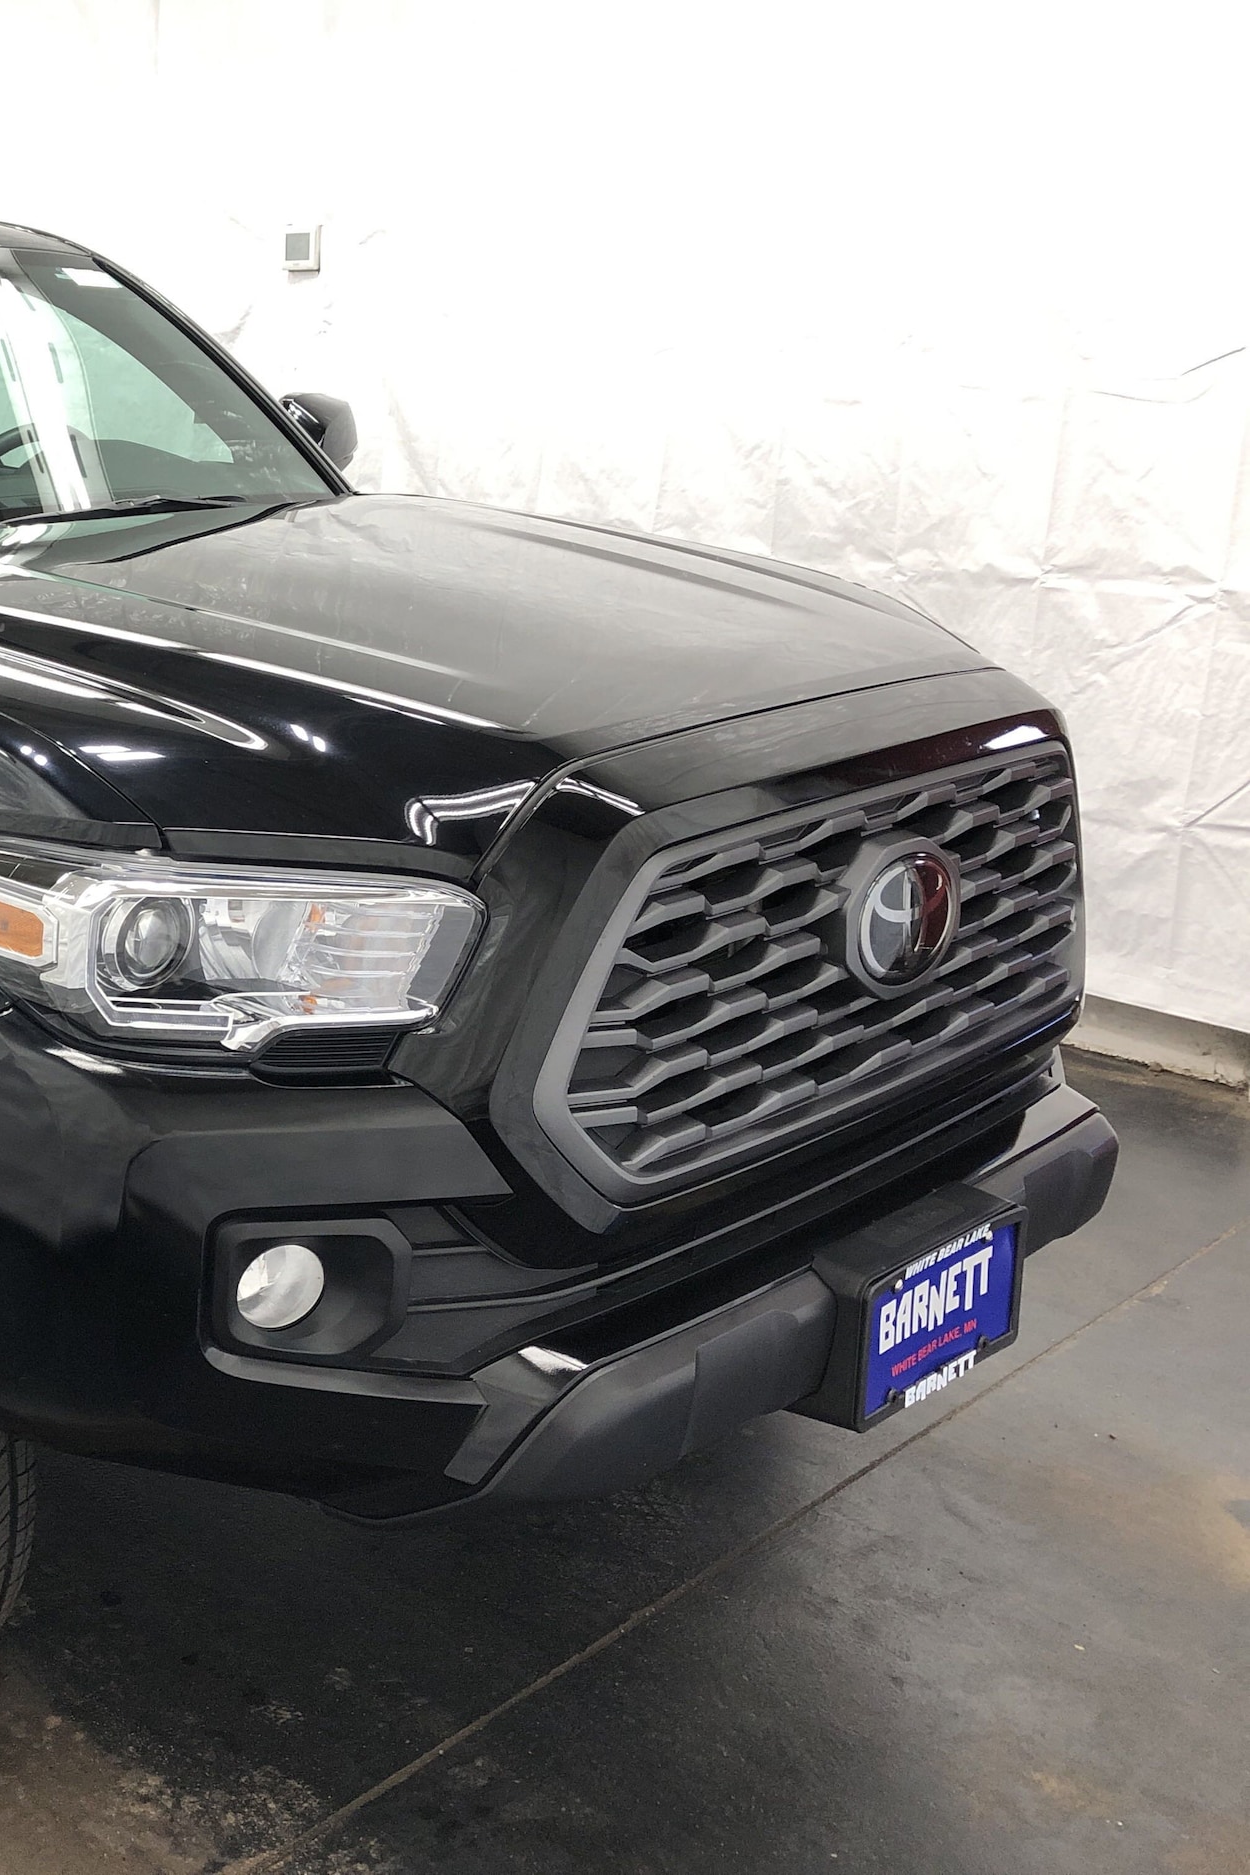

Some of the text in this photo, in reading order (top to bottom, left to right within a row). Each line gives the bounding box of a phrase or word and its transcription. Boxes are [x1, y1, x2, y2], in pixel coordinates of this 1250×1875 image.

[905, 1223, 991, 1280] WHITE BEAR LAKE
[879, 1245, 993, 1355] BARNETT
[891, 1355, 917, 1377] WHITE
[917, 1341, 939, 1362] BEAR
[963, 1318, 977, 1335] MN
[904, 1350, 977, 1409] BARNETT
